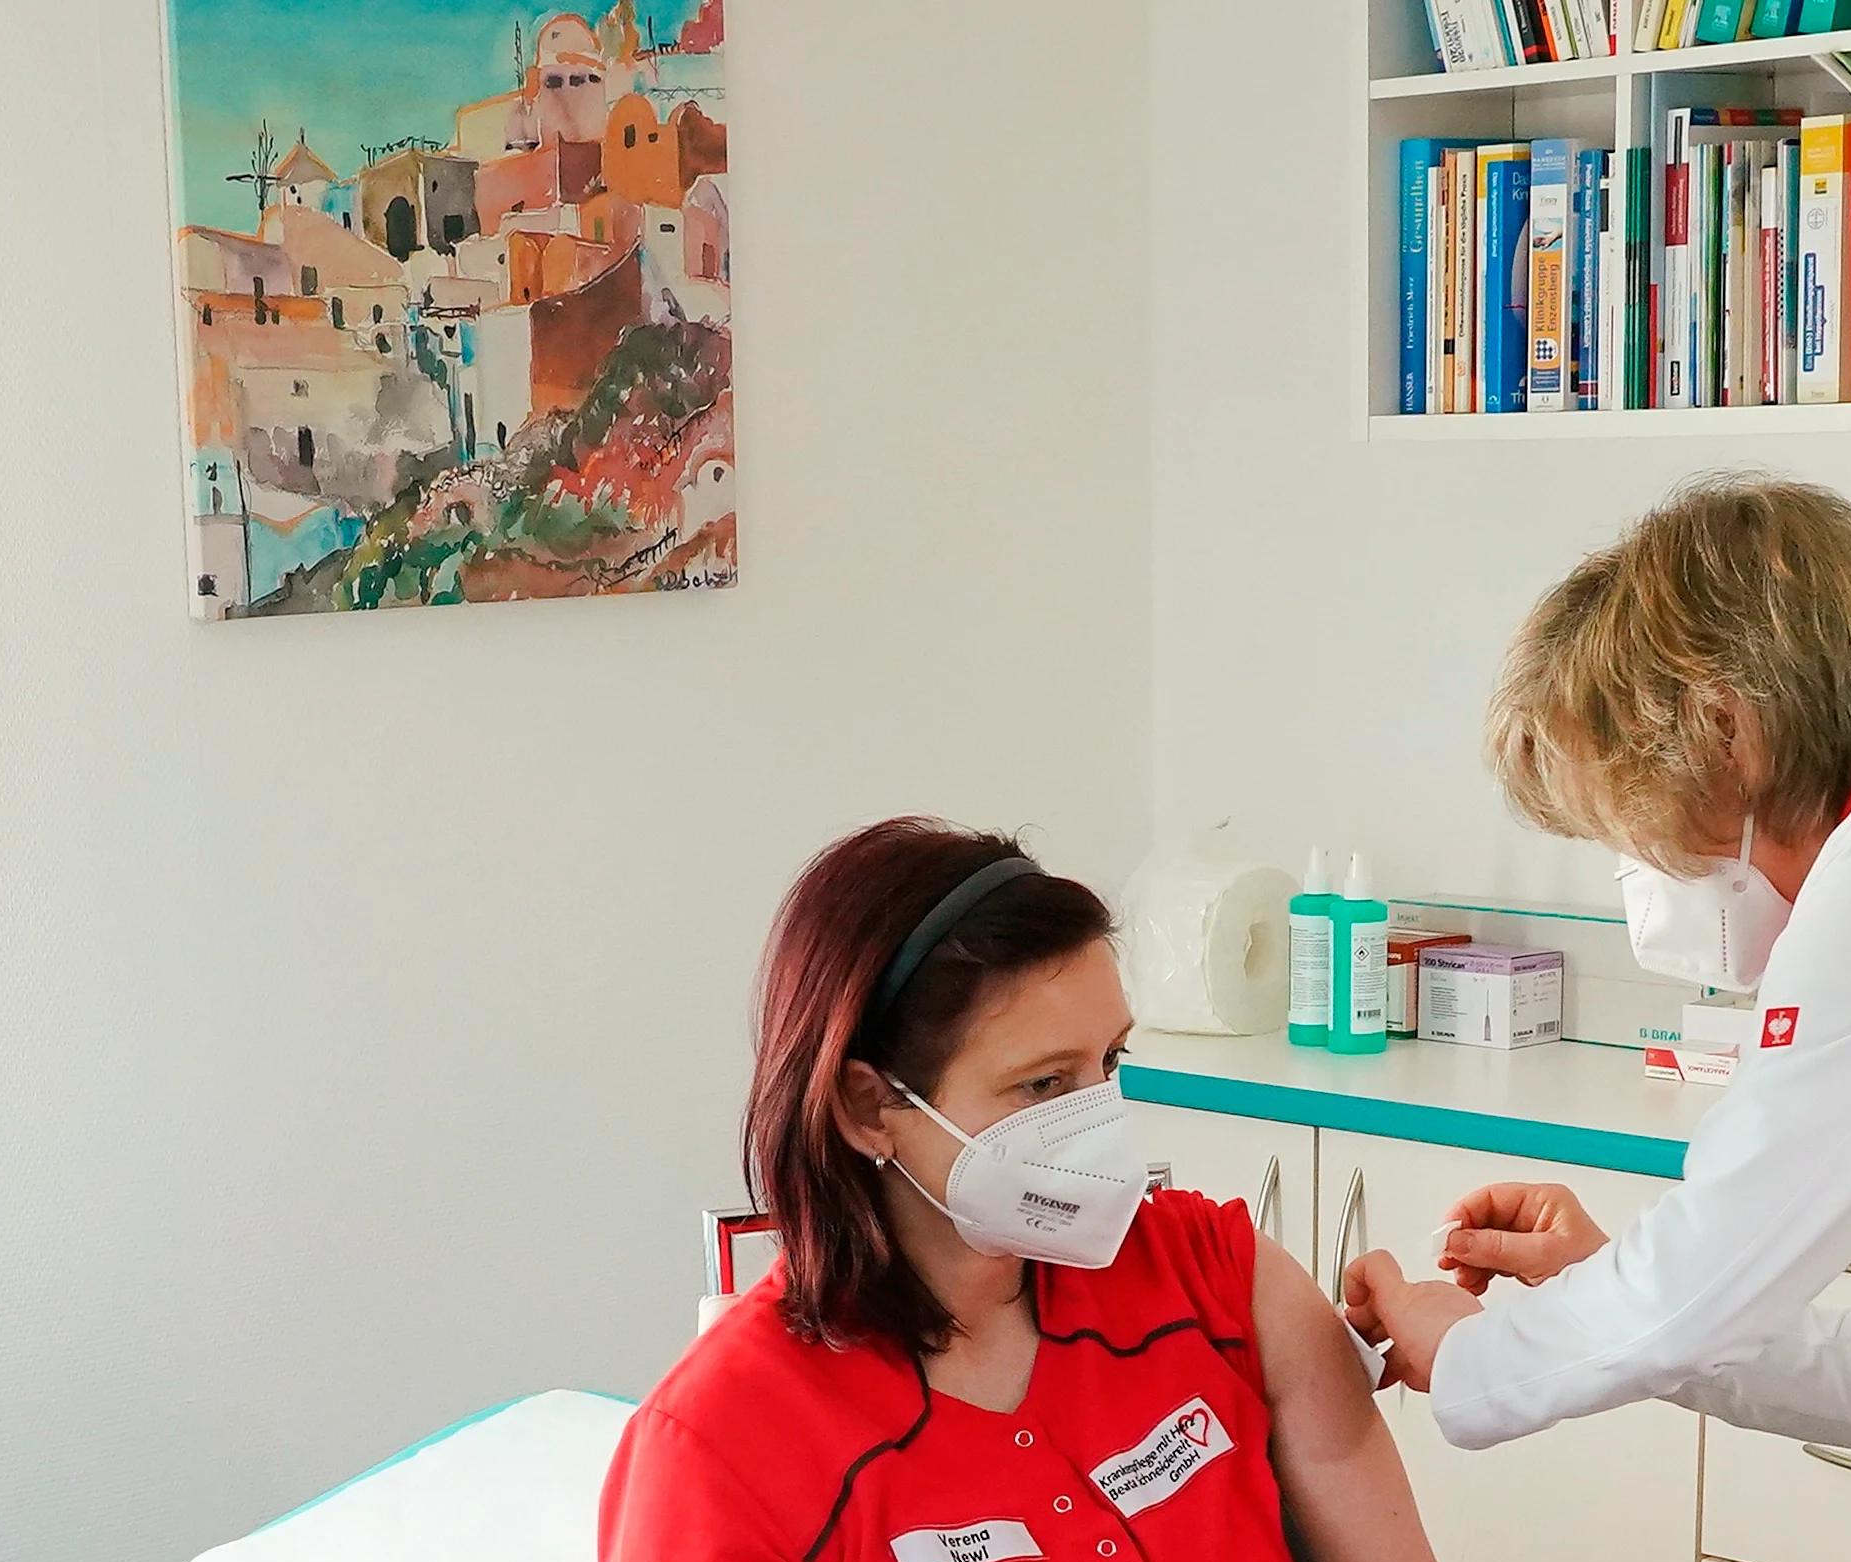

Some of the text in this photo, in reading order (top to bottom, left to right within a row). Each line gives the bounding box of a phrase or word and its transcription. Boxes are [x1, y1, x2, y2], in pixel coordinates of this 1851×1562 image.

[1535, 257, 1548, 332] Klinikgruppe
[1547, 264, 1559, 332] Enzensberg
[1397, 911, 1420, 924] Injekt
[1437, 958, 1467, 970] Sterican
[1639, 1028, 1647, 1038] B
[1168, 1449, 1202, 1484] GmbH
[937, 1528, 991, 1549] Verena
